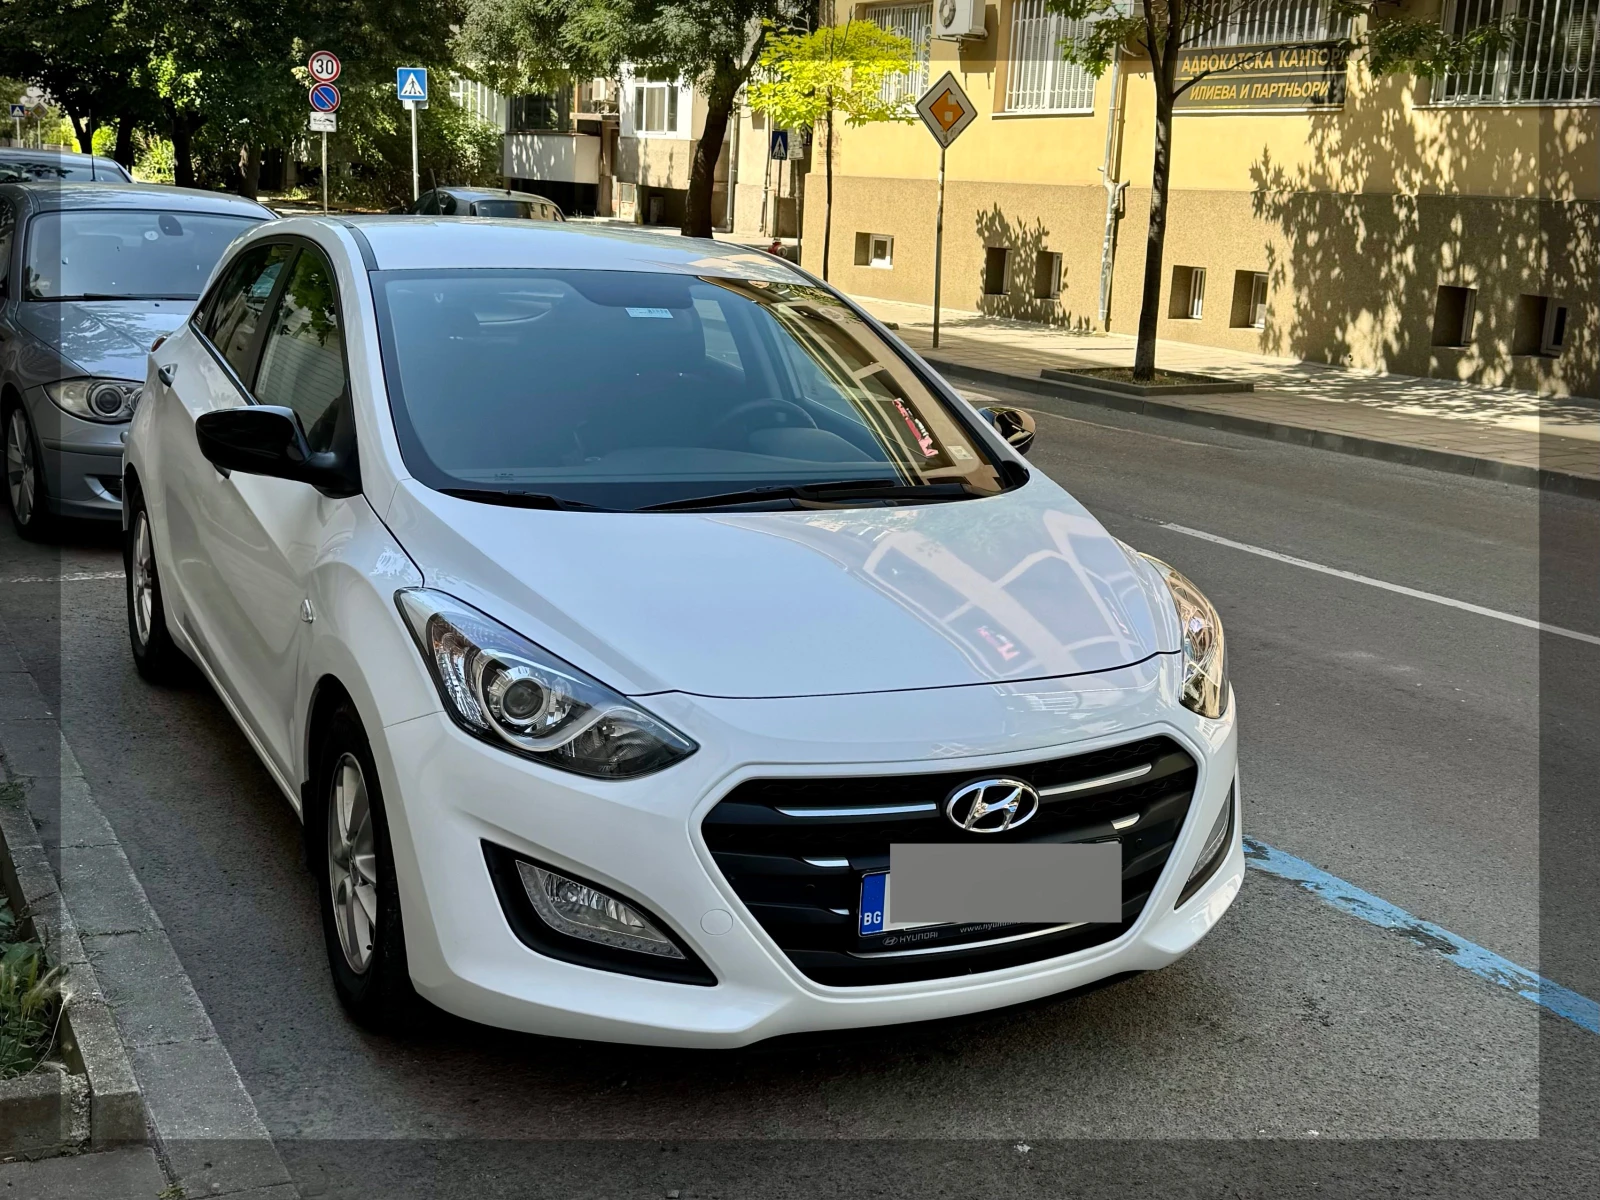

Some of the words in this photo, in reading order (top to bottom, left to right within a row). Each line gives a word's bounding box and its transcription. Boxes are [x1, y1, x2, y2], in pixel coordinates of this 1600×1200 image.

[316, 59, 334, 74] 30
[1181, 51, 1274, 74] АДВОКАТСКА
[1190, 85, 1237, 100] ИЛИЕВА
[1239, 83, 1251, 99] И
[1251, 81, 1330, 98] ПАРТНЬОРИ
[864, 911, 881, 925] BG
[899, 931, 938, 943] HYUNDAI
